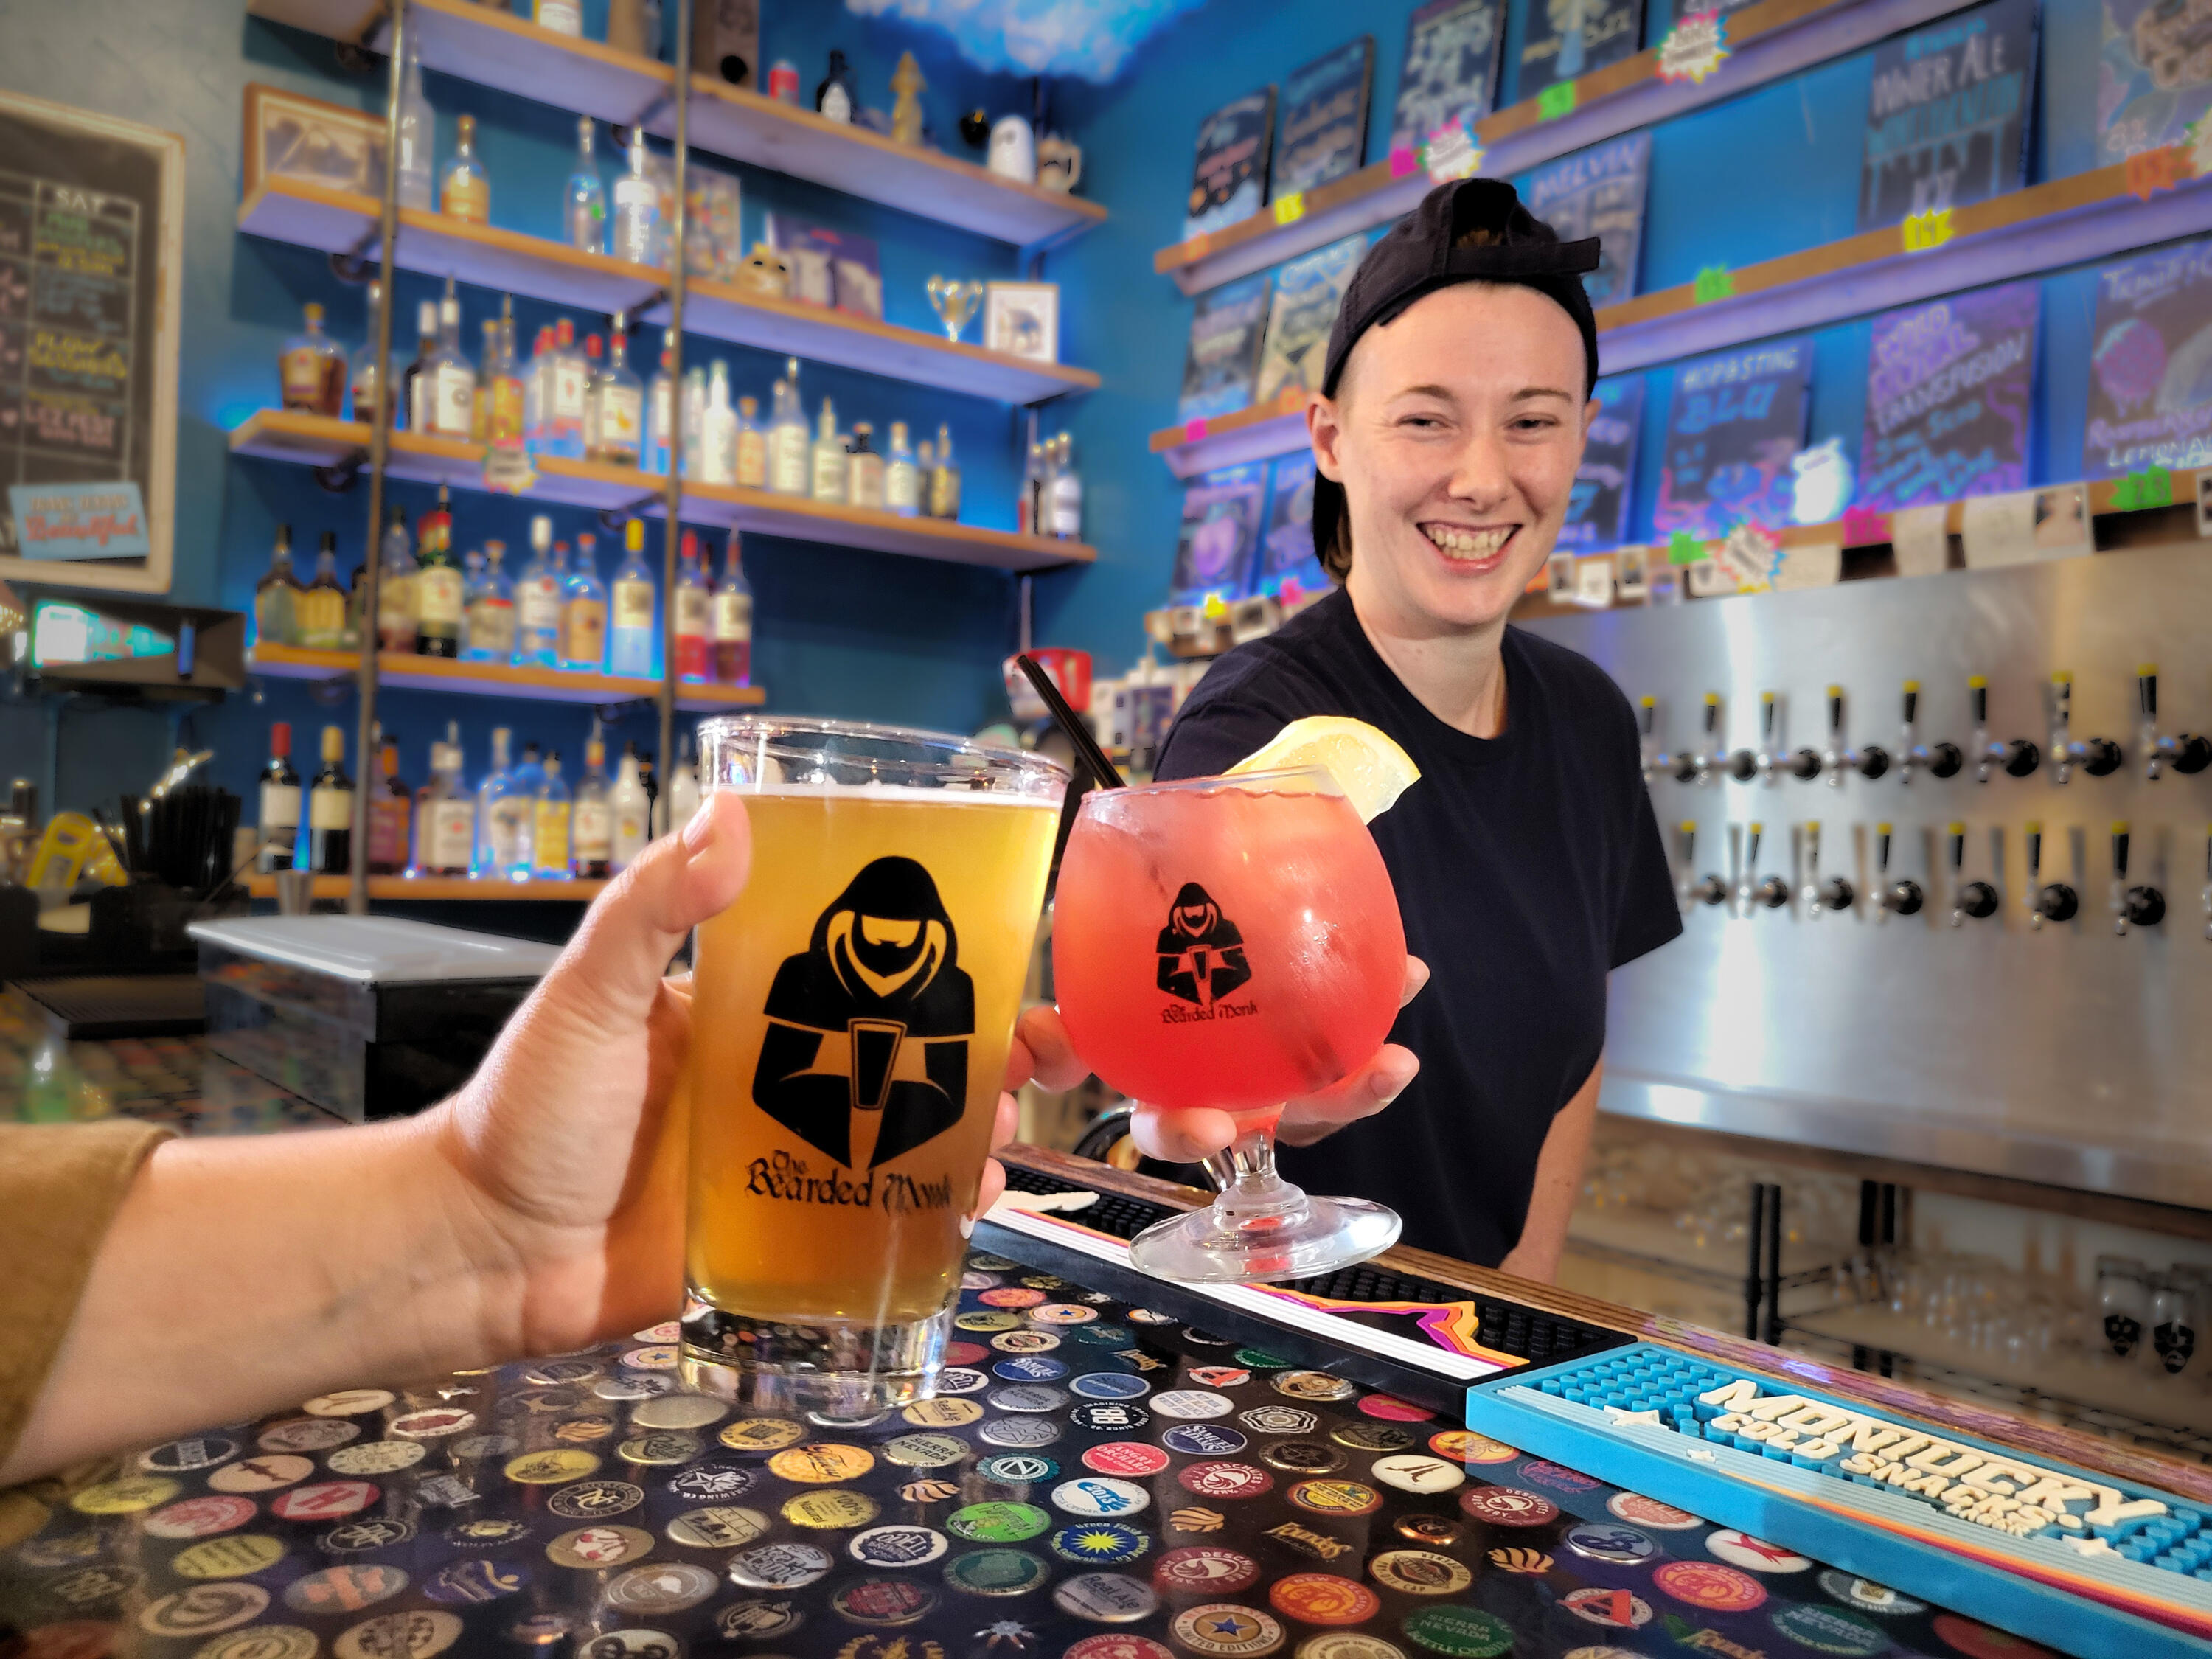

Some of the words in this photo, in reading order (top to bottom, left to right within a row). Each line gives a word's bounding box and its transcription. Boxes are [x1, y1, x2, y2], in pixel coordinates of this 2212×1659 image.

[1958, 35, 2005, 88] ALE
[1533, 139, 1643, 209] MELVIN
[55, 187, 105, 215] SAT
[1675, 383, 1780, 434] BLU
[745, 1157, 875, 1209] Bearded
[911, 1436, 958, 1457] SIERRA
[1180, 1430, 1220, 1453] ADAMS
[1186, 1425, 1237, 1451] SAMUEL
[1711, 1411, 1840, 1460] COLD
[895, 1440, 949, 1462] NEVADA
[1096, 1446, 1151, 1472] ORCHARD
[1111, 1444, 1155, 1464] ANGRY
[1698, 1379, 2168, 1527] MONTUCKY
[1191, 1478, 1239, 1495] BREWERY
[1205, 1462, 1265, 1485] DESCHUTES
[799, 1500, 829, 1523] Natural
[832, 1494, 865, 1517] 100%
[1471, 1494, 1510, 1518] BREWERY
[1506, 1488, 1549, 1515] DESCHUTES
[1074, 1521, 1110, 1529] Green
[1113, 1523, 1144, 1536] Flash
[1260, 1521, 1354, 1560] Founders
[1200, 1551, 1254, 1582] DESCHUTES
[1673, 1564, 1708, 1572] NEW
[1083, 1575, 1114, 1596] Real
[1116, 1593, 1141, 1609] Ale
[1293, 1575, 1329, 1585] NEW
[1339, 1579, 1368, 1614] BELGIUM
[1402, 1584, 1426, 1593] CAP
[1183, 1604, 1276, 1630] NEWCASTLE
[1180, 1625, 1215, 1649] LIMITED
